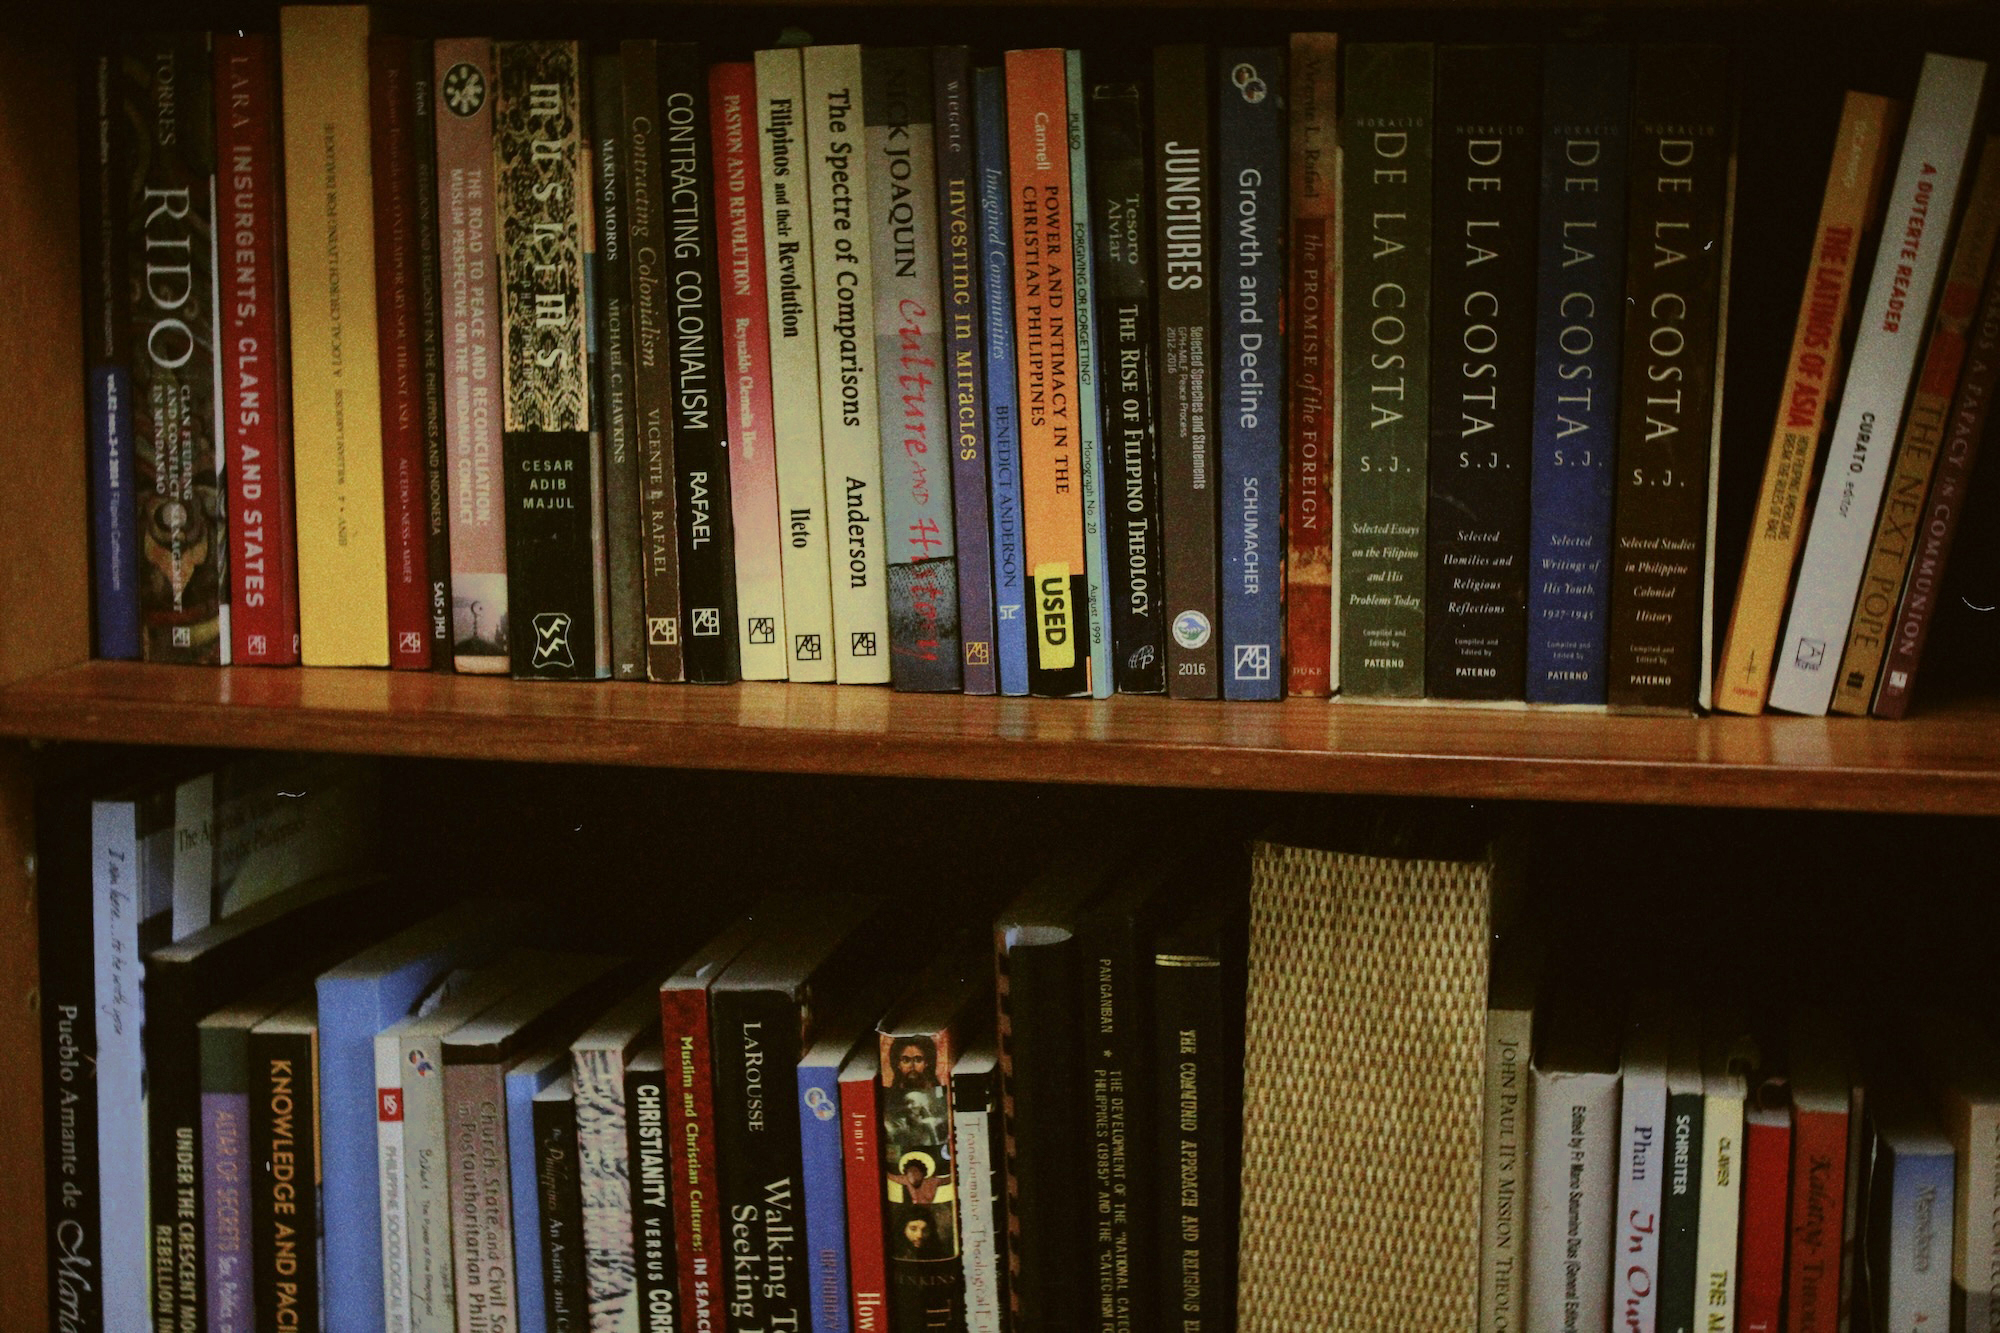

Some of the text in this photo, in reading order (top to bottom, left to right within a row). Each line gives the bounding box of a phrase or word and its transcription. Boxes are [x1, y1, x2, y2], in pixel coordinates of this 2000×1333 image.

[1033, 112, 1050, 170] Cannell
[1069, 113, 1081, 151] PULSO
[602, 138, 619, 261] MAKING MOROS
[630, 116, 661, 366] Contracting Colonialism
[766, 98, 803, 339] Filipinos and their Revolution
[884, 147, 917, 278] JOAQUIN
[1107, 199, 1122, 261] Alviar
[1125, 193, 1141, 265] Tesoro
[1165, 141, 1203, 290] JUNCTURES
[144, 185, 194, 367] RIDO
[667, 92, 708, 430] CONTRACTING COLONIALISM
[728, 196, 750, 297] REVOLUTION
[825, 88, 864, 427] The Spectre of Comparisons
[981, 168, 1008, 359] Imagined Communities
[1370, 132, 1407, 430] DE LA COSTA
[1461, 139, 1502, 438] DE LA COSTA
[1556, 139, 1600, 440] DE LA COSTA
[1644, 139, 1694, 442] DE LA COSTA
[1820, 226, 1853, 266] THE
[1882, 162, 1937, 334] A DUTERTE READER
[1022, 186, 1047, 427] CHRISTIAN PHILIPPINES
[1044, 186, 1070, 494] POWER AND INTIMACY IN THE
[1074, 222, 1092, 385] FORGIVING FORGETTING?
[1239, 168, 1264, 429] Growth and Decline
[1804, 266, 1844, 350] LATINOS
[232, 145, 266, 608] INSURGENTS, CLANS, AND STATES
[607, 298, 626, 464] MICHAEL HAWKINS
[1189, 326, 1207, 489] Selected Speeches and Statements
[1301, 268, 1320, 530] PROMISE FOREIGN
[1787, 381, 1820, 428] ASIA
[522, 459, 575, 472] CESAR
[523, 497, 575, 509] MAJUL
[529, 478, 567, 491] ADIB
[646, 408, 667, 577] VICENTE RAFAEL
[995, 405, 1018, 587] BENEDICT ANDERSON
[1117, 303, 1150, 618] THE RISE FILIPINO THEOLOGY
[1360, 456, 1412, 473] S.J.
[1459, 452, 1511, 469] S.J.
[1554, 451, 1603, 467] S.J.
[690, 471, 711, 551] RAFAEL
[790, 507, 811, 548] Ileto
[845, 476, 869, 589] Anderson
[1243, 476, 1260, 594] SCHUMACHER
[1352, 523, 1420, 536] Selected Essays
[1382, 547, 1419, 560] Filipino
[1456, 531, 1499, 542] Selected
[1549, 535, 1592, 546] Selected
[1619, 536, 1696, 550] Selected Studies
[1854, 405, 1943, 648] THE NEXT POPE
[1350, 594, 1421, 608] Problems Today
[1443, 554, 1513, 566] Homilies and
[1452, 578, 1501, 591] Religious
[1541, 559, 1587, 571] Writings
[1633, 586, 1675, 597] Colonial
[1638, 562, 1688, 577] Philippine
[1041, 577, 1068, 646] USED
[1447, 602, 1505, 614] Reflections
[1543, 608, 1593, 620] 1927-1945
[1635, 610, 1672, 623] History
[1178, 663, 1206, 675] 2016
[1292, 666, 1323, 676] DUKE
[1364, 658, 1405, 668] PATERNO
[1455, 667, 1497, 677] PATERNO
[1547, 671, 1589, 681] PATERNO
[1630, 674, 1672, 686] PATERNO
[58, 1004, 84, 1208] Pueblo Amante de
[636, 1084, 667, 1208] CHRISTIANITY
[851, 1112, 867, 1162] Jomier
[1497, 1038, 1519, 1249] JOHN PAUL MISSION
[1571, 1105, 1586, 1136] Edited
[269, 1059, 297, 1276] KNOWLEDGE AND
[680, 1036, 708, 1276] Muslim and Christian Cultures: IN
[1093, 1069, 1112, 1242] PHILIPPINES AND THE
[1109, 1070, 1129, 1290] THE DEVELOPMENT THE "NATIONAL
[1179, 1030, 1201, 1312] THE COMMUNIO APPROACH AND RELIGIOUS
[1632, 1125, 1653, 1182] Phan
[1671, 1114, 1691, 1196] SCHREITER
[175, 1127, 197, 1303] UNDER CRESCENT
[761, 1176, 794, 1299] Walking
[1628, 1210, 1654, 1254] In
[548, 1218, 570, 1314] An Asiatic and
[729, 1204, 761, 1318] Seeking
